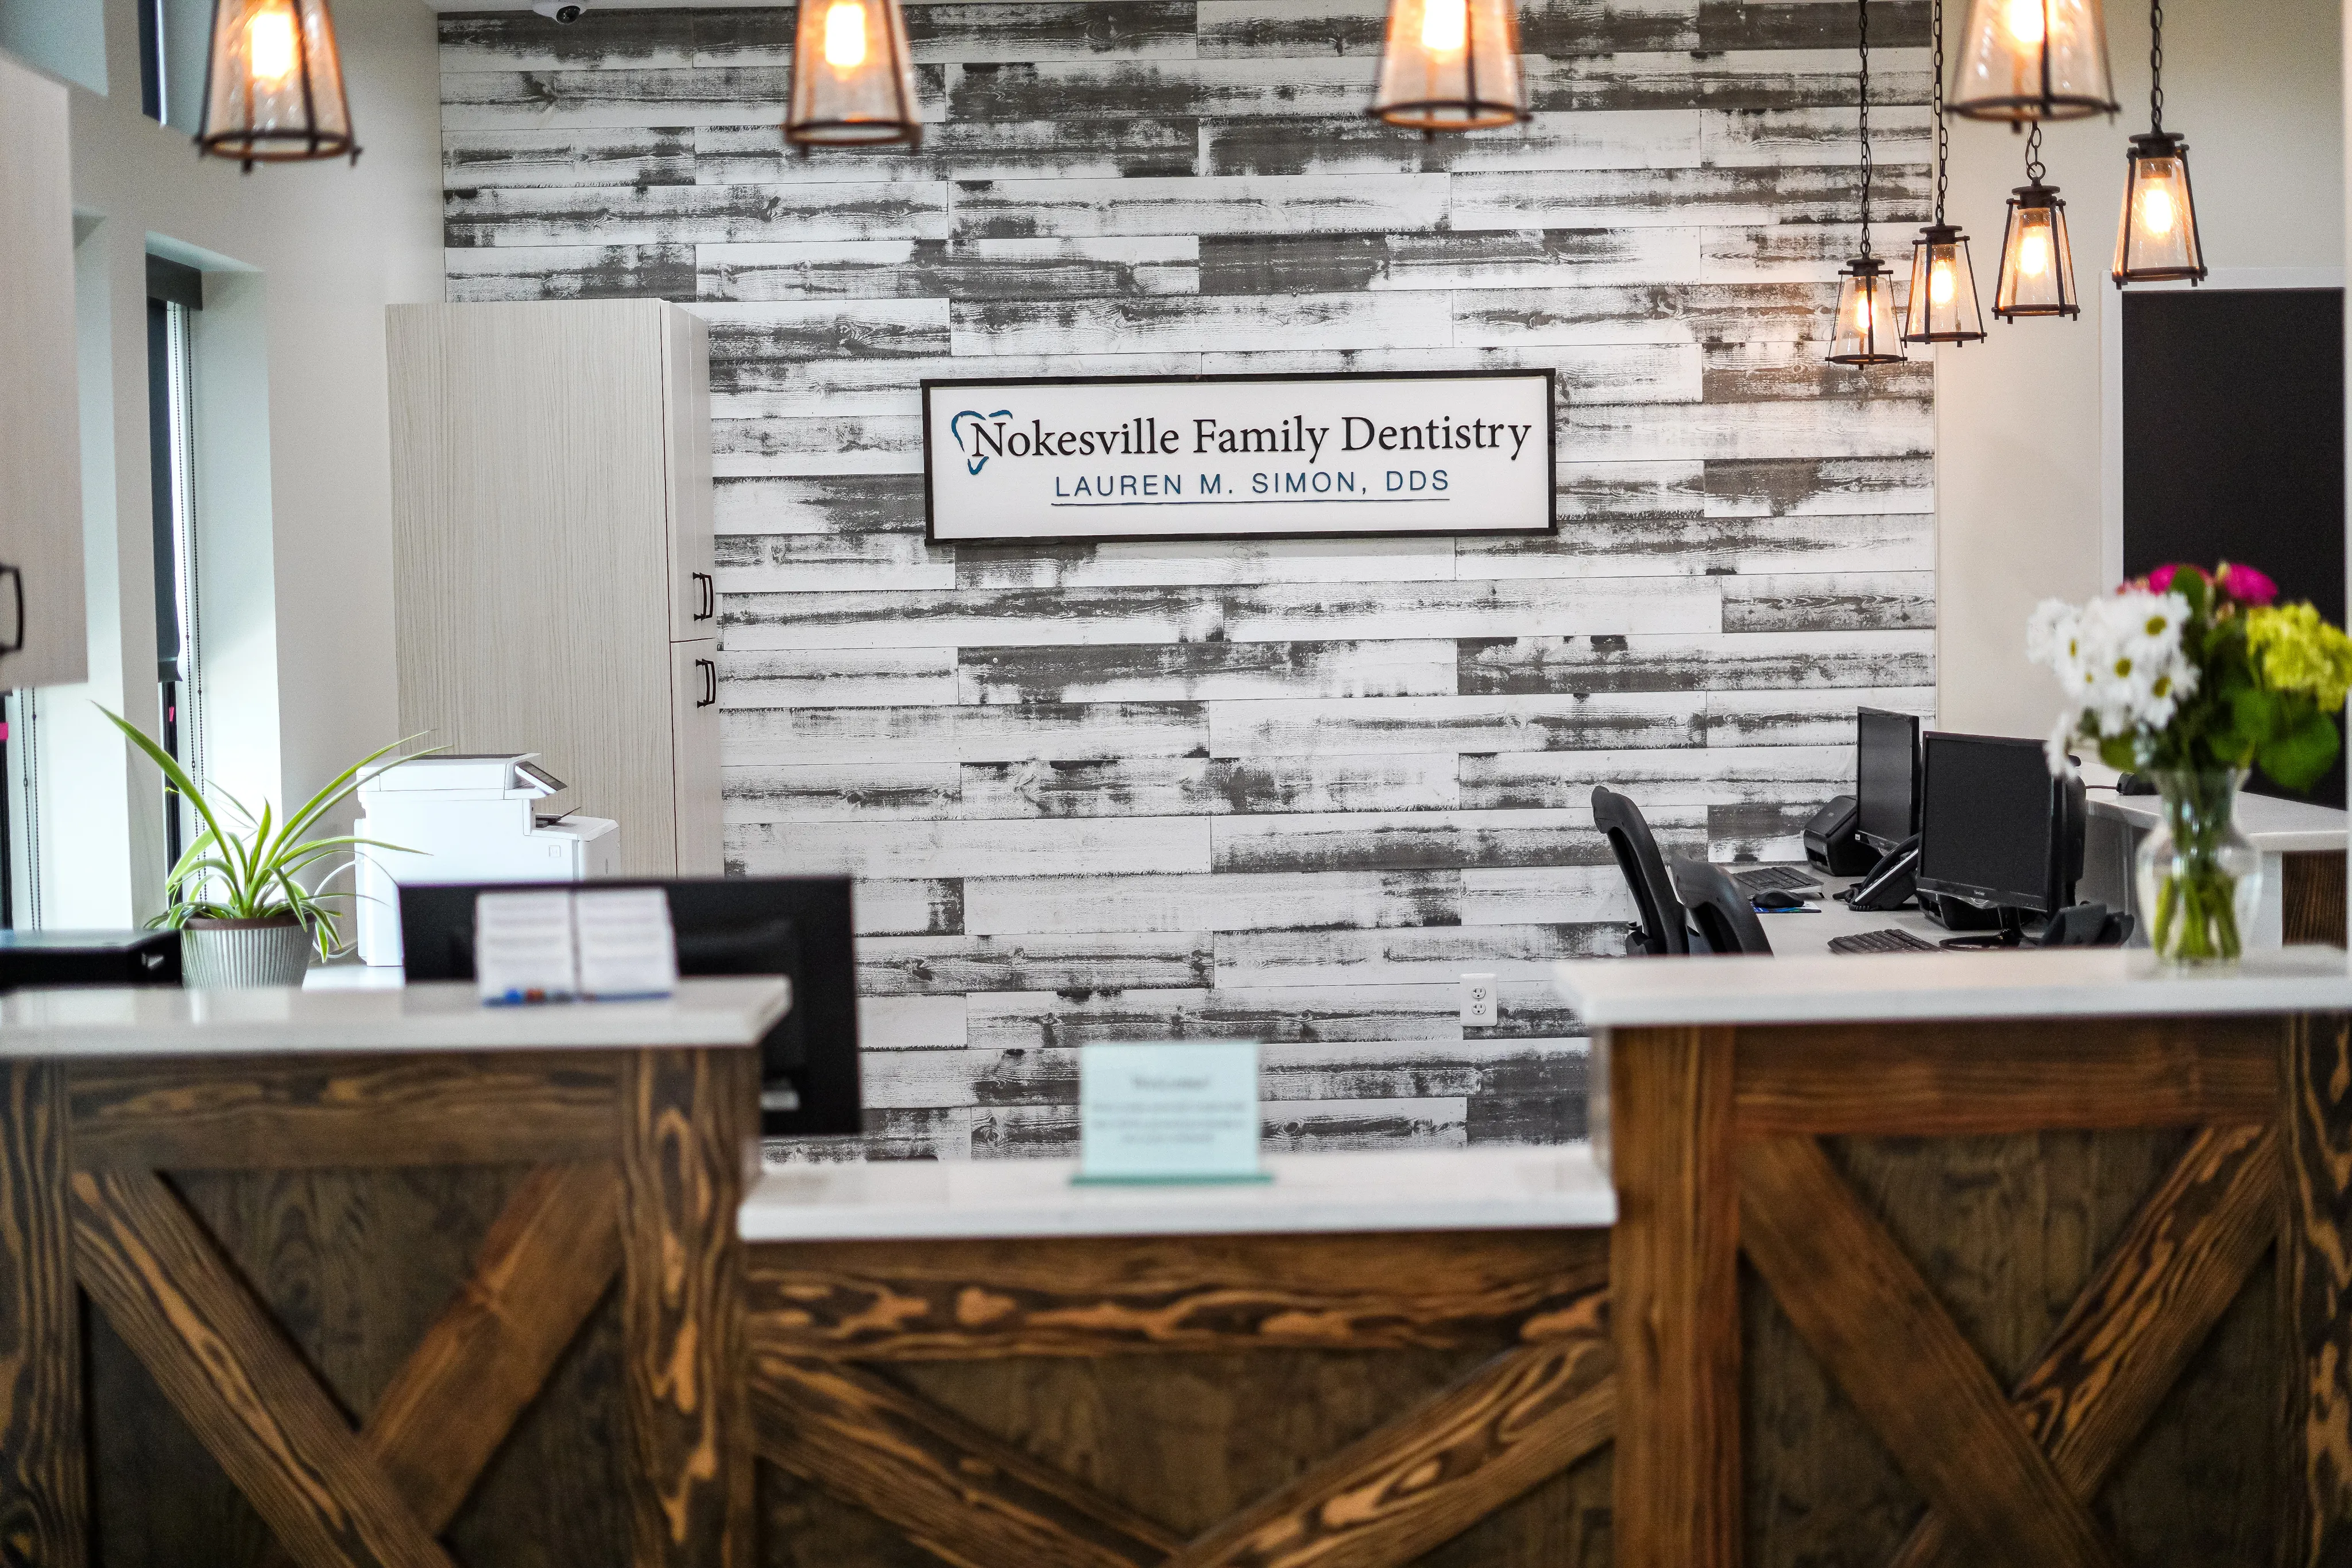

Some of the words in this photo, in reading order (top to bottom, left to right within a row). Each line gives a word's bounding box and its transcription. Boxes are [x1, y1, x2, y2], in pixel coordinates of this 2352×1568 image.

[970, 417, 1179, 457] Nokesville
[1193, 415, 1330, 464] Family
[1341, 415, 1532, 461] Dentistry
[1057, 474, 1181, 497] LAUREN
[1201, 474, 1234, 494] M.
[1252, 471, 1366, 495] SIMON,
[1386, 470, 1449, 491] DDS
